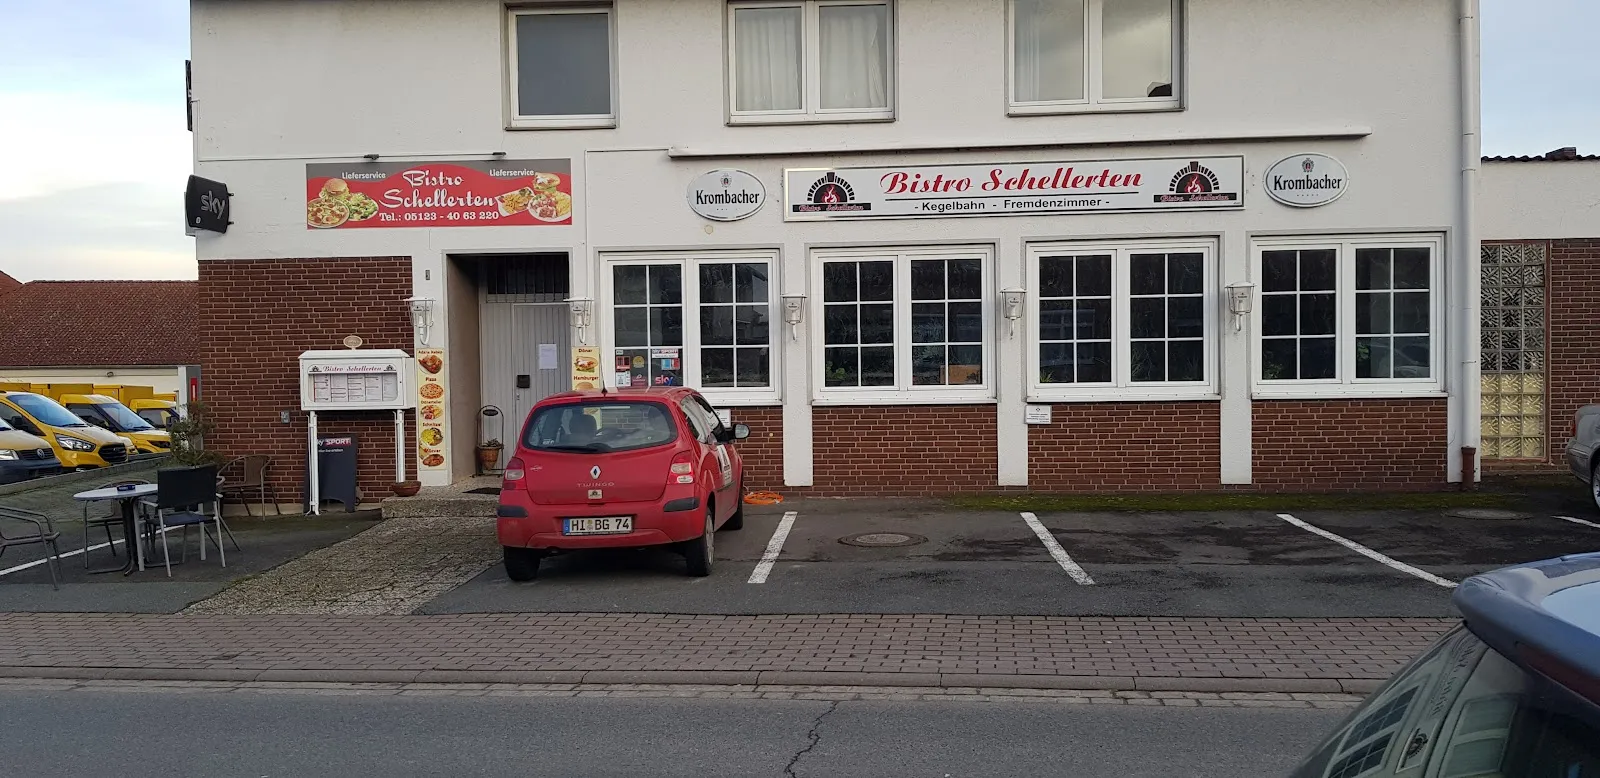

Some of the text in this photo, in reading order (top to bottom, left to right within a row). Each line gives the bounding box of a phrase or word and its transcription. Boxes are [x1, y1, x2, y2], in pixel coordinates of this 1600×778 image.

[341, 171, 386, 179] Lieferservice
[402, 169, 464, 187] Bistro
[489, 168, 534, 177] Lieferservice
[880, 167, 1145, 194] Bistro Schellerten
[1274, 174, 1342, 190] Krombacher
[379, 188, 497, 208] Schellerten
[696, 189, 760, 204] Krombacher
[200, 190, 226, 220] sky
[922, 201, 985, 212] Kegelbahn
[1004, 198, 1102, 209] Fremdenzimmer
[379, 212, 402, 222] Tel.:
[404, 212, 437, 221] 05123
[447, 212, 460, 220] 40
[463, 211, 476, 220] 63
[479, 211, 499, 220] 220
[655, 375, 673, 386] sky
[571, 518, 630, 531] HI BG 74
